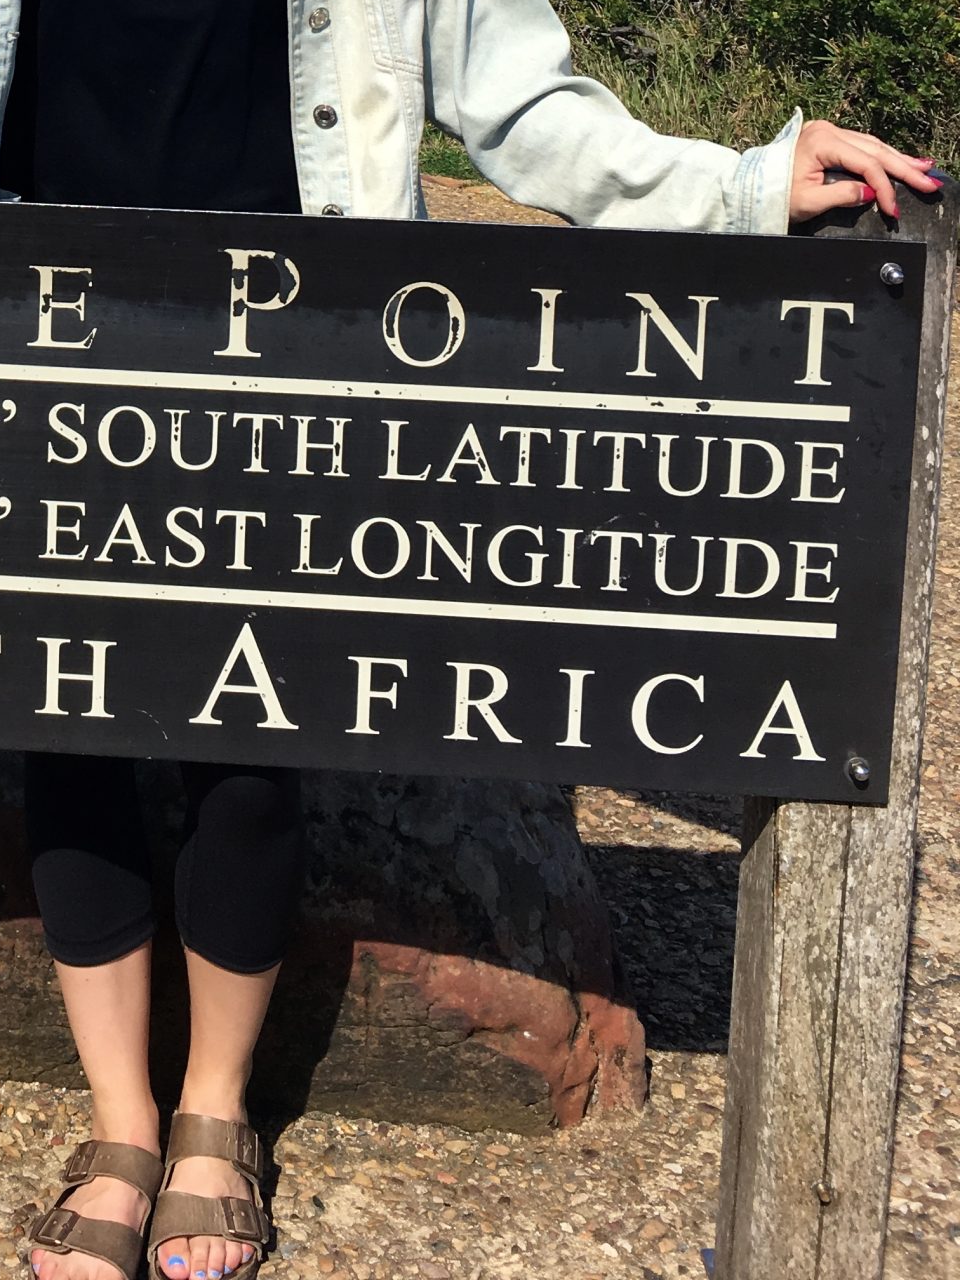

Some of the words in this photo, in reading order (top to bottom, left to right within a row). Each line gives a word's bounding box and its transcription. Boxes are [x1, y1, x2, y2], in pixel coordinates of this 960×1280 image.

[214, 249, 853, 385] POINT
[48, 403, 352, 476] SOUTH
[379, 420, 845, 503] LATITUDE
[39, 500, 265, 569] EAST
[291, 514, 839, 603] LONGITUDE
[189, 623, 826, 761] AFRICA
